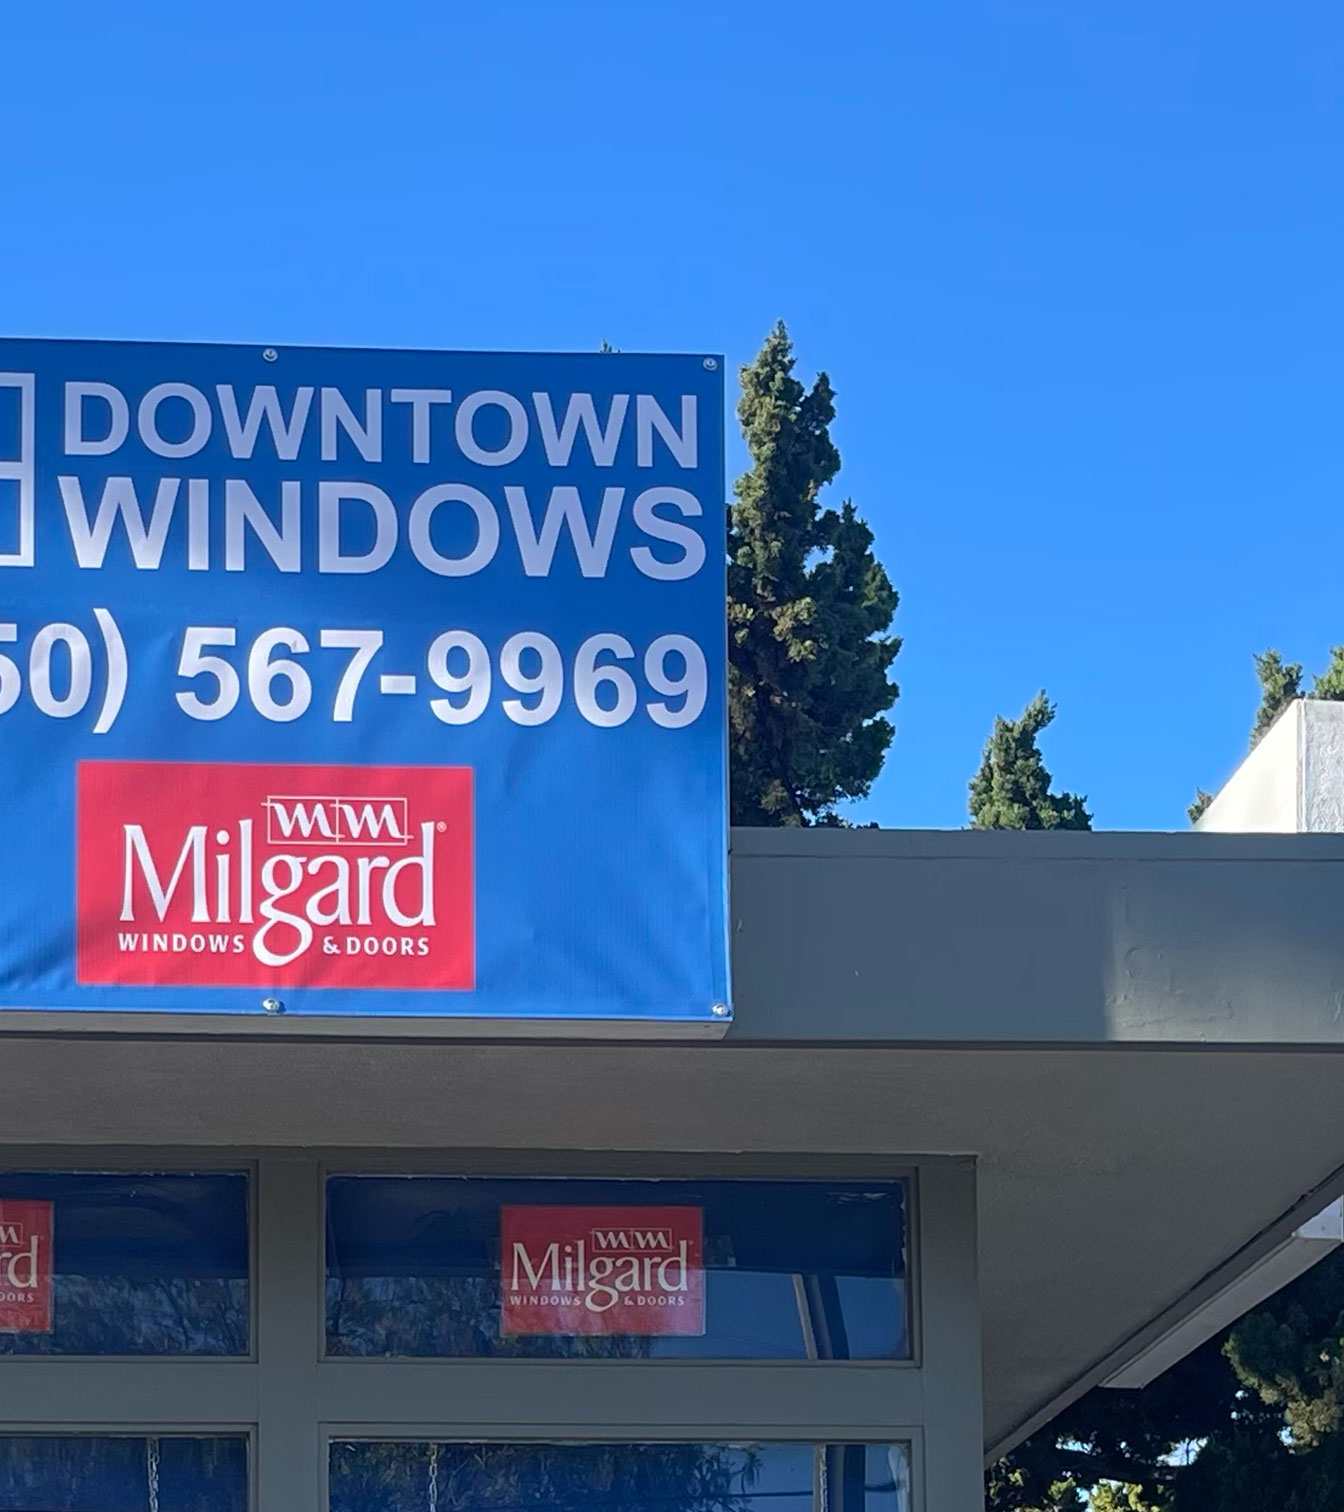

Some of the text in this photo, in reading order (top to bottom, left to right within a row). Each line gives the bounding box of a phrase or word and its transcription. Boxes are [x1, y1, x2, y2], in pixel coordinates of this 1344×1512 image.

[63, 381, 698, 468] DOWNTOWN
[58, 475, 707, 581] WINDOWS
[175, 625, 708, 729] 567-9969
[119, 818, 437, 967] Milgard
[118, 932, 430, 957] WINDOWS & DOORS
[509, 1295, 582, 1307] WINDOWS
[637, 1295, 685, 1306] DOORS
[510, 1239, 688, 1313] Milgard
